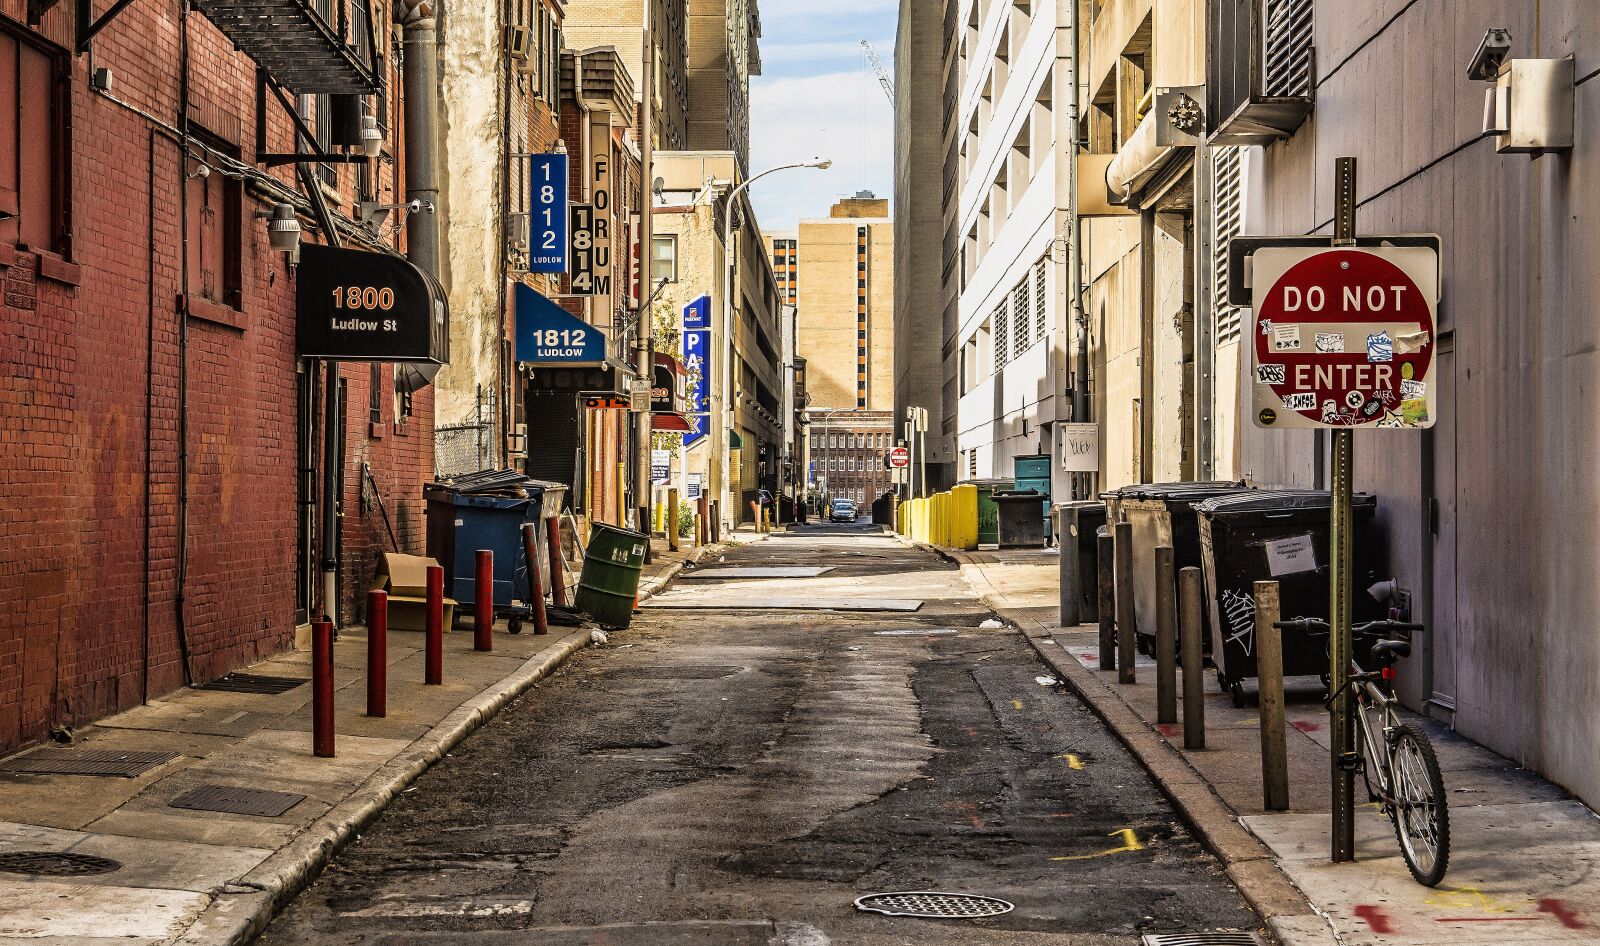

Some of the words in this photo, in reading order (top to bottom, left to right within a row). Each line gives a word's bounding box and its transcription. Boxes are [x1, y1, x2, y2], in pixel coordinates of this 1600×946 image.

[540, 162, 556, 249] 1812
[594, 161, 610, 295] FORUM
[533, 256, 562, 264] LUDLOW
[572, 210, 592, 291] 1814
[332, 286, 394, 310] 1800
[1283, 285, 1325, 312] DO
[1342, 285, 1407, 312] NOT
[331, 318, 378, 331] Ludlow
[383, 319, 397, 332] St
[533, 329, 586, 347] 1812
[537, 348, 583, 357] LUDLOW
[1295, 364, 1393, 390] ENTER
